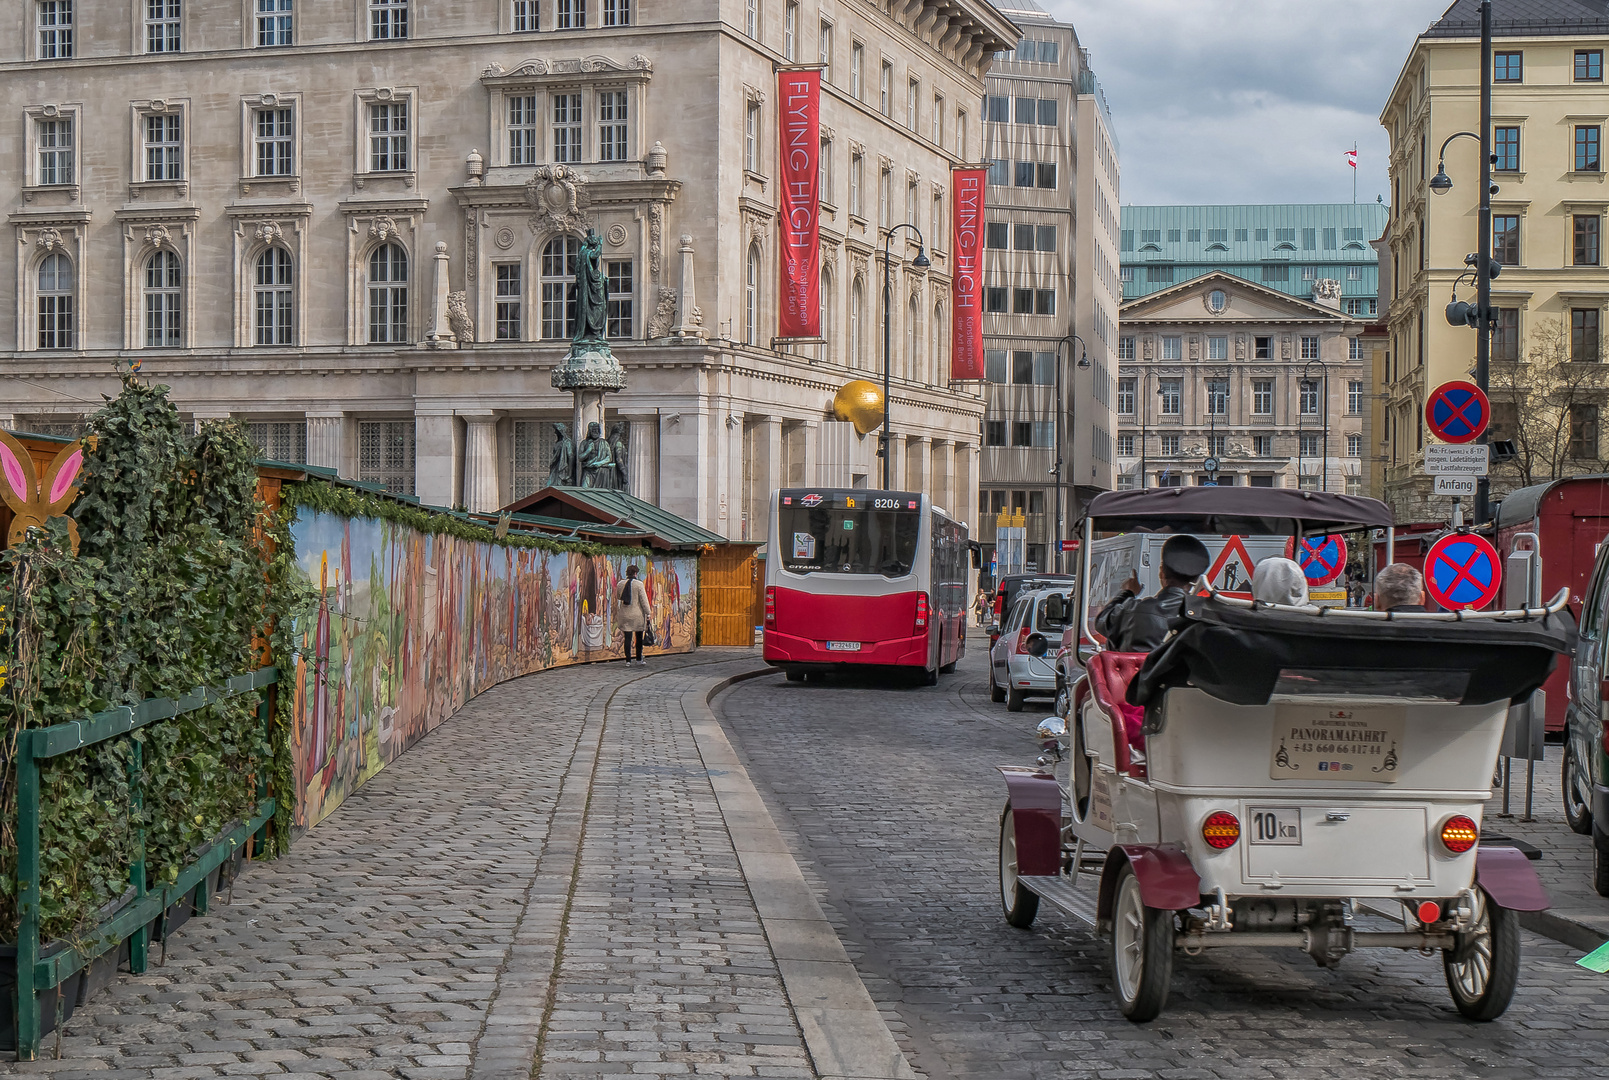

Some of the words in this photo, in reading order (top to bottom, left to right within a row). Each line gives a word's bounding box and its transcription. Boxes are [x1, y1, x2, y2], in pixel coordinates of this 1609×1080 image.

[788, 81, 809, 172] FLYING
[790, 181, 811, 248] HIGH
[959, 177, 978, 249] FLYING
[788, 258, 798, 276] der
[788, 277, 797, 293] Art
[957, 255, 975, 308] HIGH
[799, 258, 809, 326] Künstlerinnen
[788, 296, 797, 316] Brut
[1439, 479, 1473, 492] Anfang
[845, 496, 856, 508] 1A
[874, 498, 900, 509] 8206
[1290, 727, 1388, 743] PANORAMAFAHRT
[1293, 743, 1313, 753] +43
[1316, 743, 1335, 754] 660
[1254, 812, 1277, 840] 10
